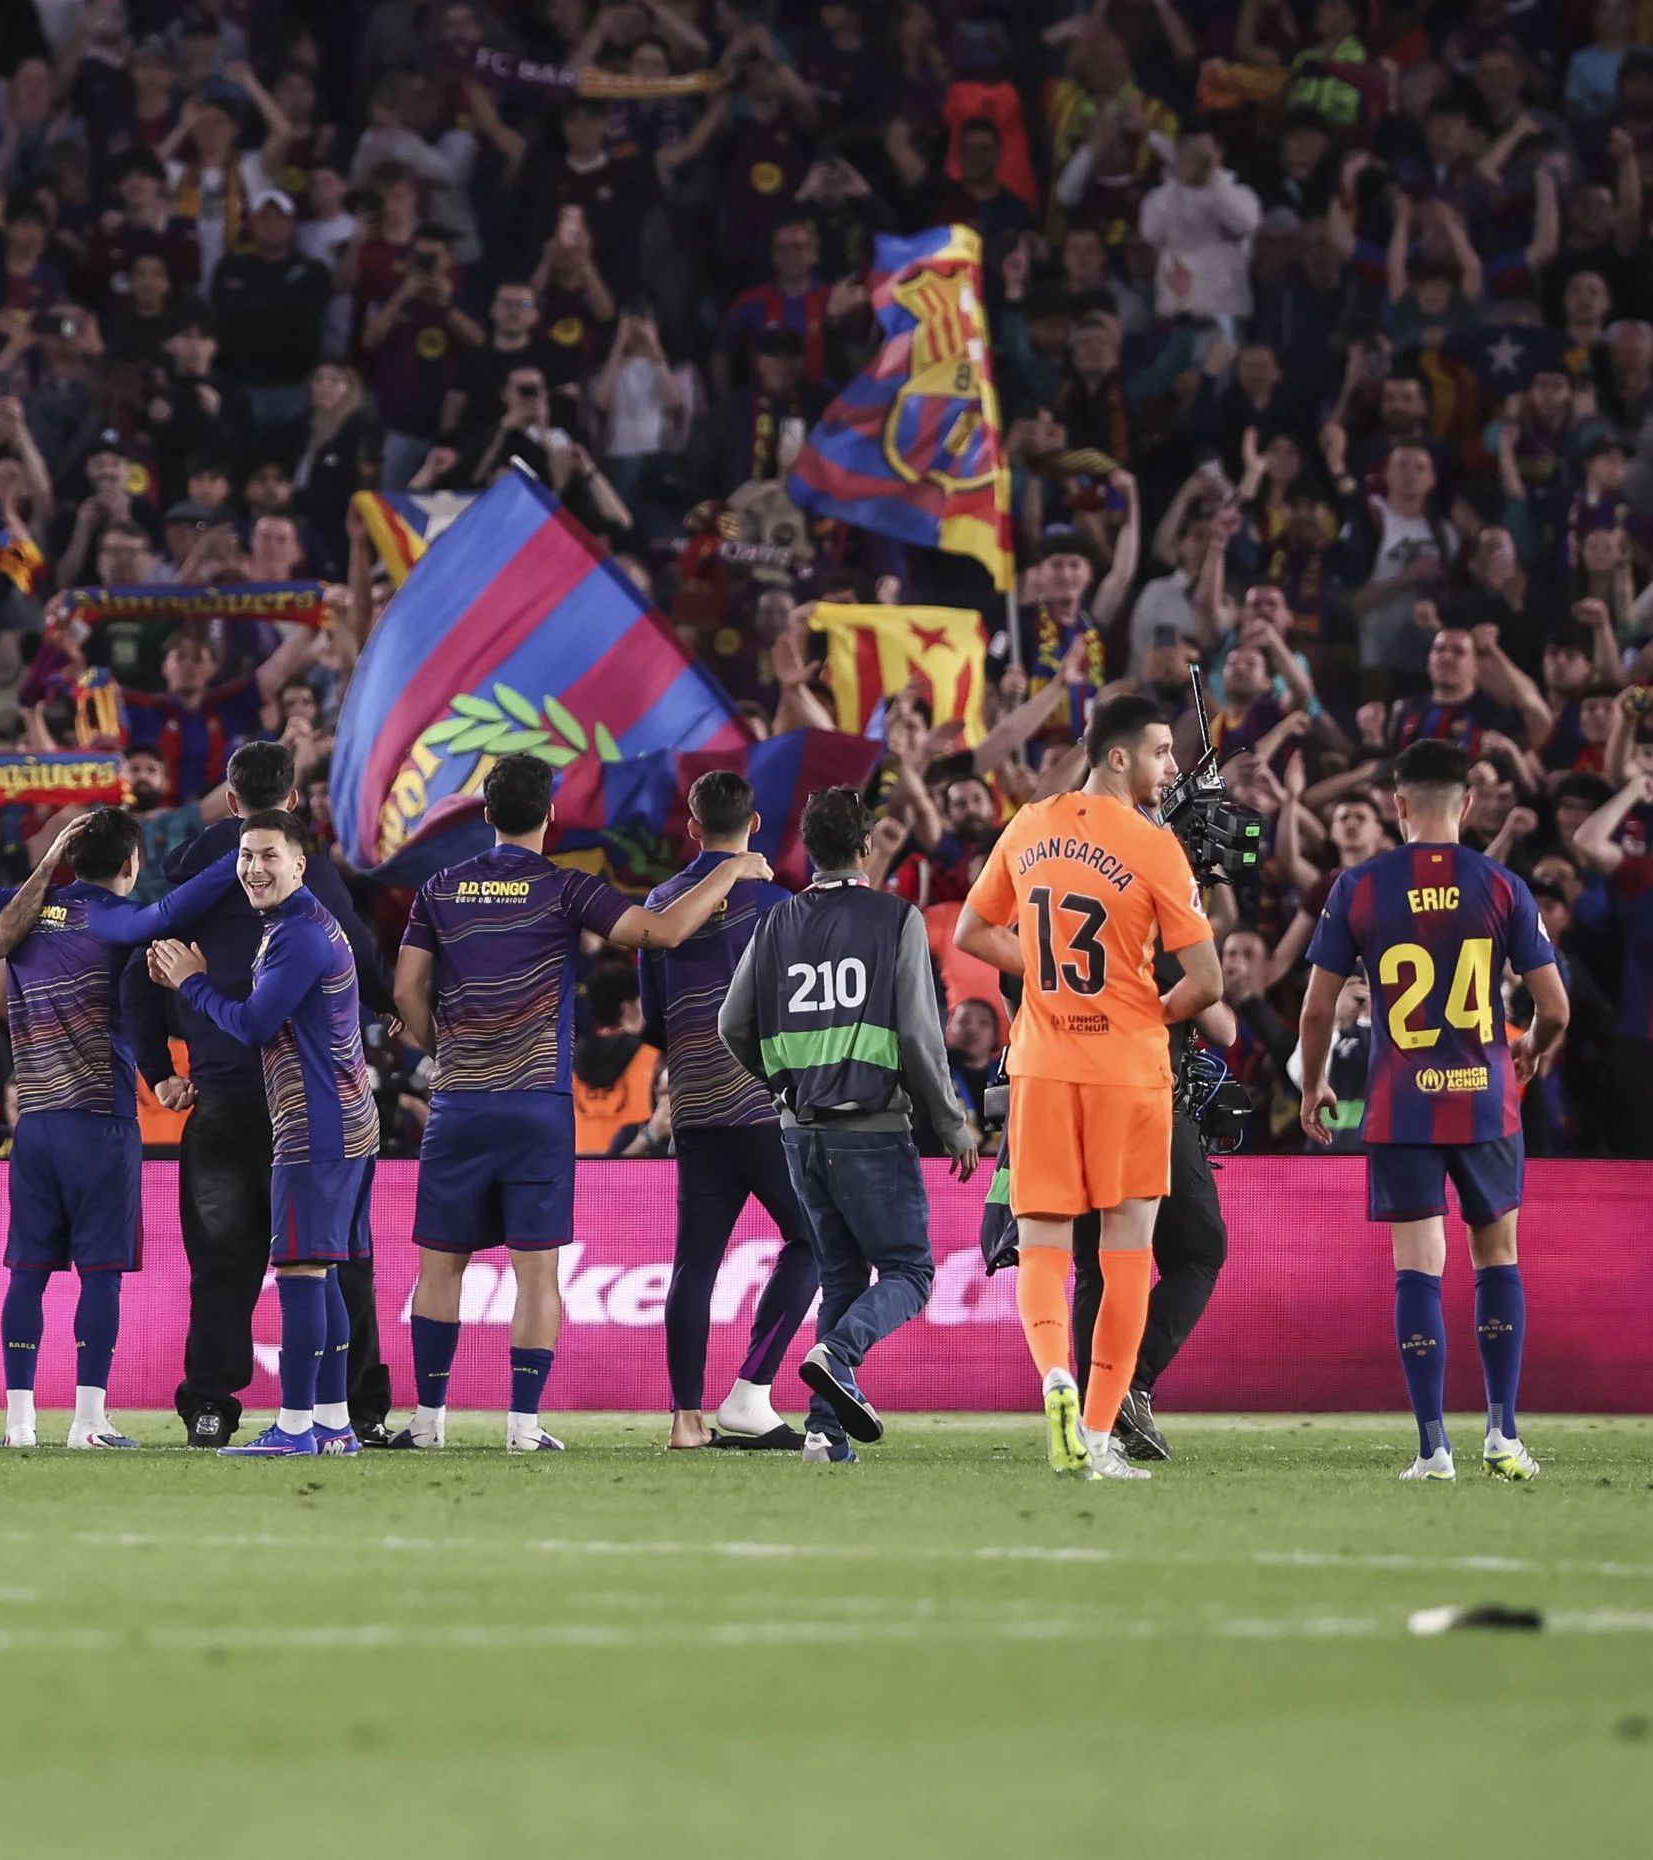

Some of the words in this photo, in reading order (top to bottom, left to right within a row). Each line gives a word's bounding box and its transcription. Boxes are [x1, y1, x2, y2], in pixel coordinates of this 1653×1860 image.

[1018, 836, 1061, 876] JOAN
[1064, 837, 1134, 893] GARCIA
[457, 881, 480, 896] R.D.
[481, 881, 530, 896] CONGO
[1407, 886, 1461, 914] ERIC
[1027, 888, 1109, 996] 13
[787, 956, 867, 1013] 210
[1379, 938, 1494, 1050] 24
[1067, 1014, 1108, 1024] UNHCR
[1067, 1023, 1109, 1033] ACNUR
[1446, 1066, 1488, 1079] UNHCR
[1446, 1076, 1489, 1088] ACNUR
